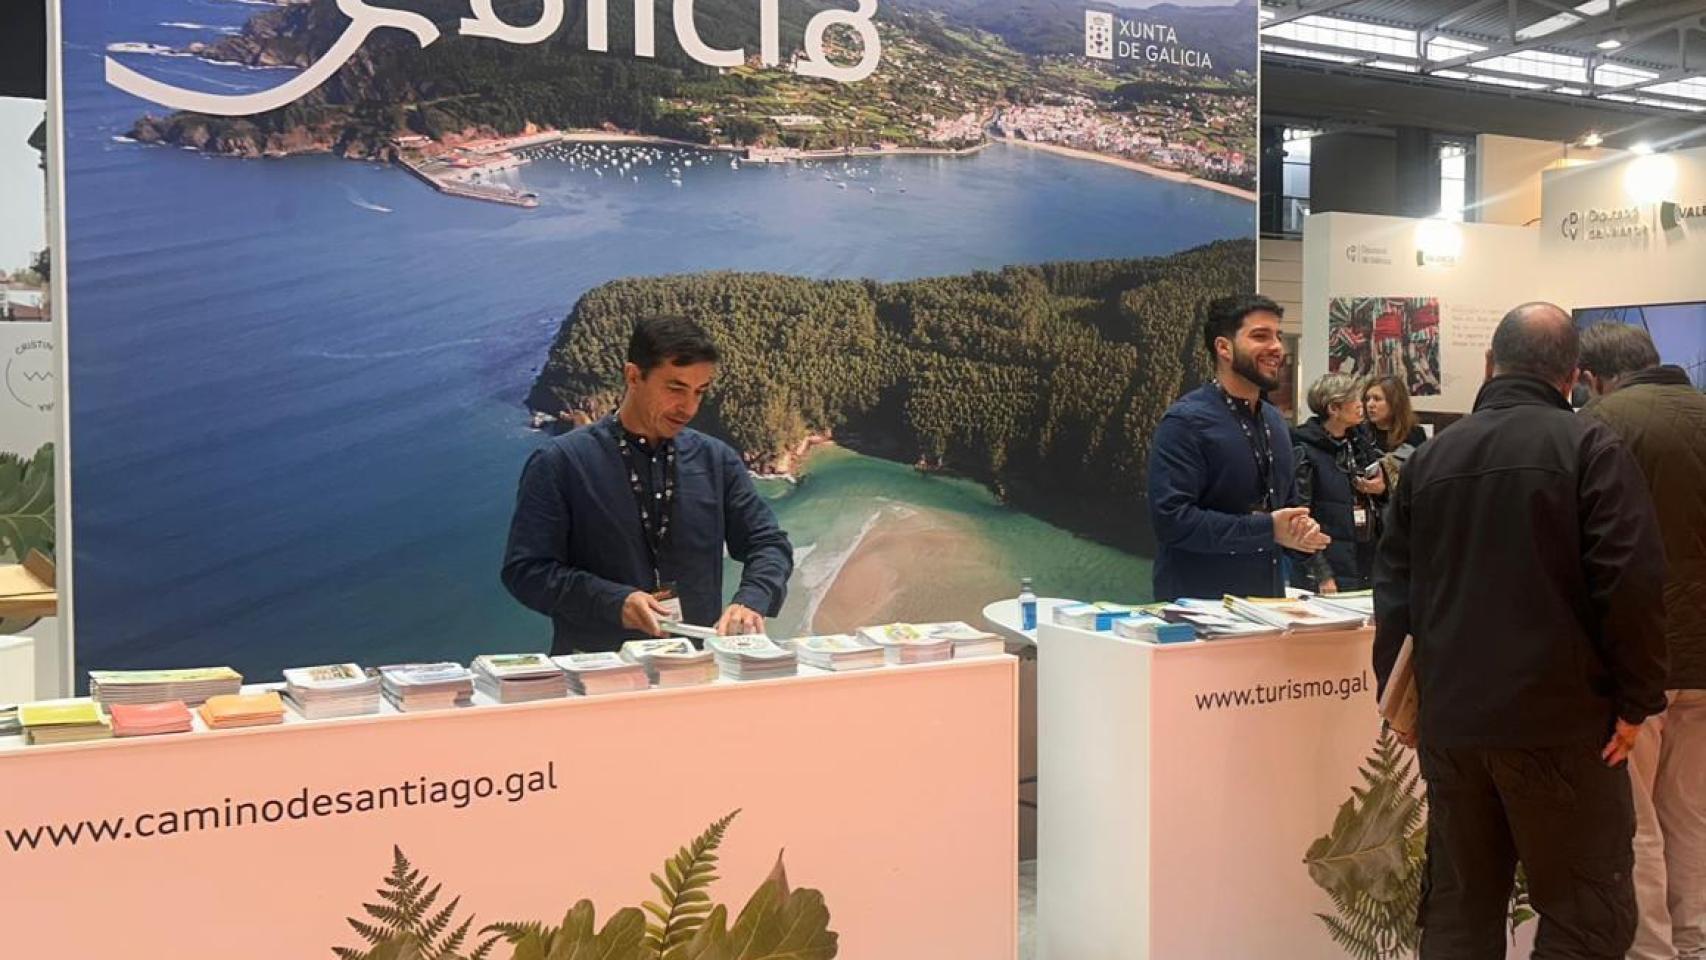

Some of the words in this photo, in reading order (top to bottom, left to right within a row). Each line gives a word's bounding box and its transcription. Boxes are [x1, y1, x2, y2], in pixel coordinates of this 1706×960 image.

[1119, 19, 1178, 44] XUNTA
[1118, 41, 1141, 60] DE
[1145, 45, 1212, 69] GALICIA
[1195, 670, 1368, 711] www.turismo.gal
[4, 761, 558, 852] www.caminodesantiago.gal
